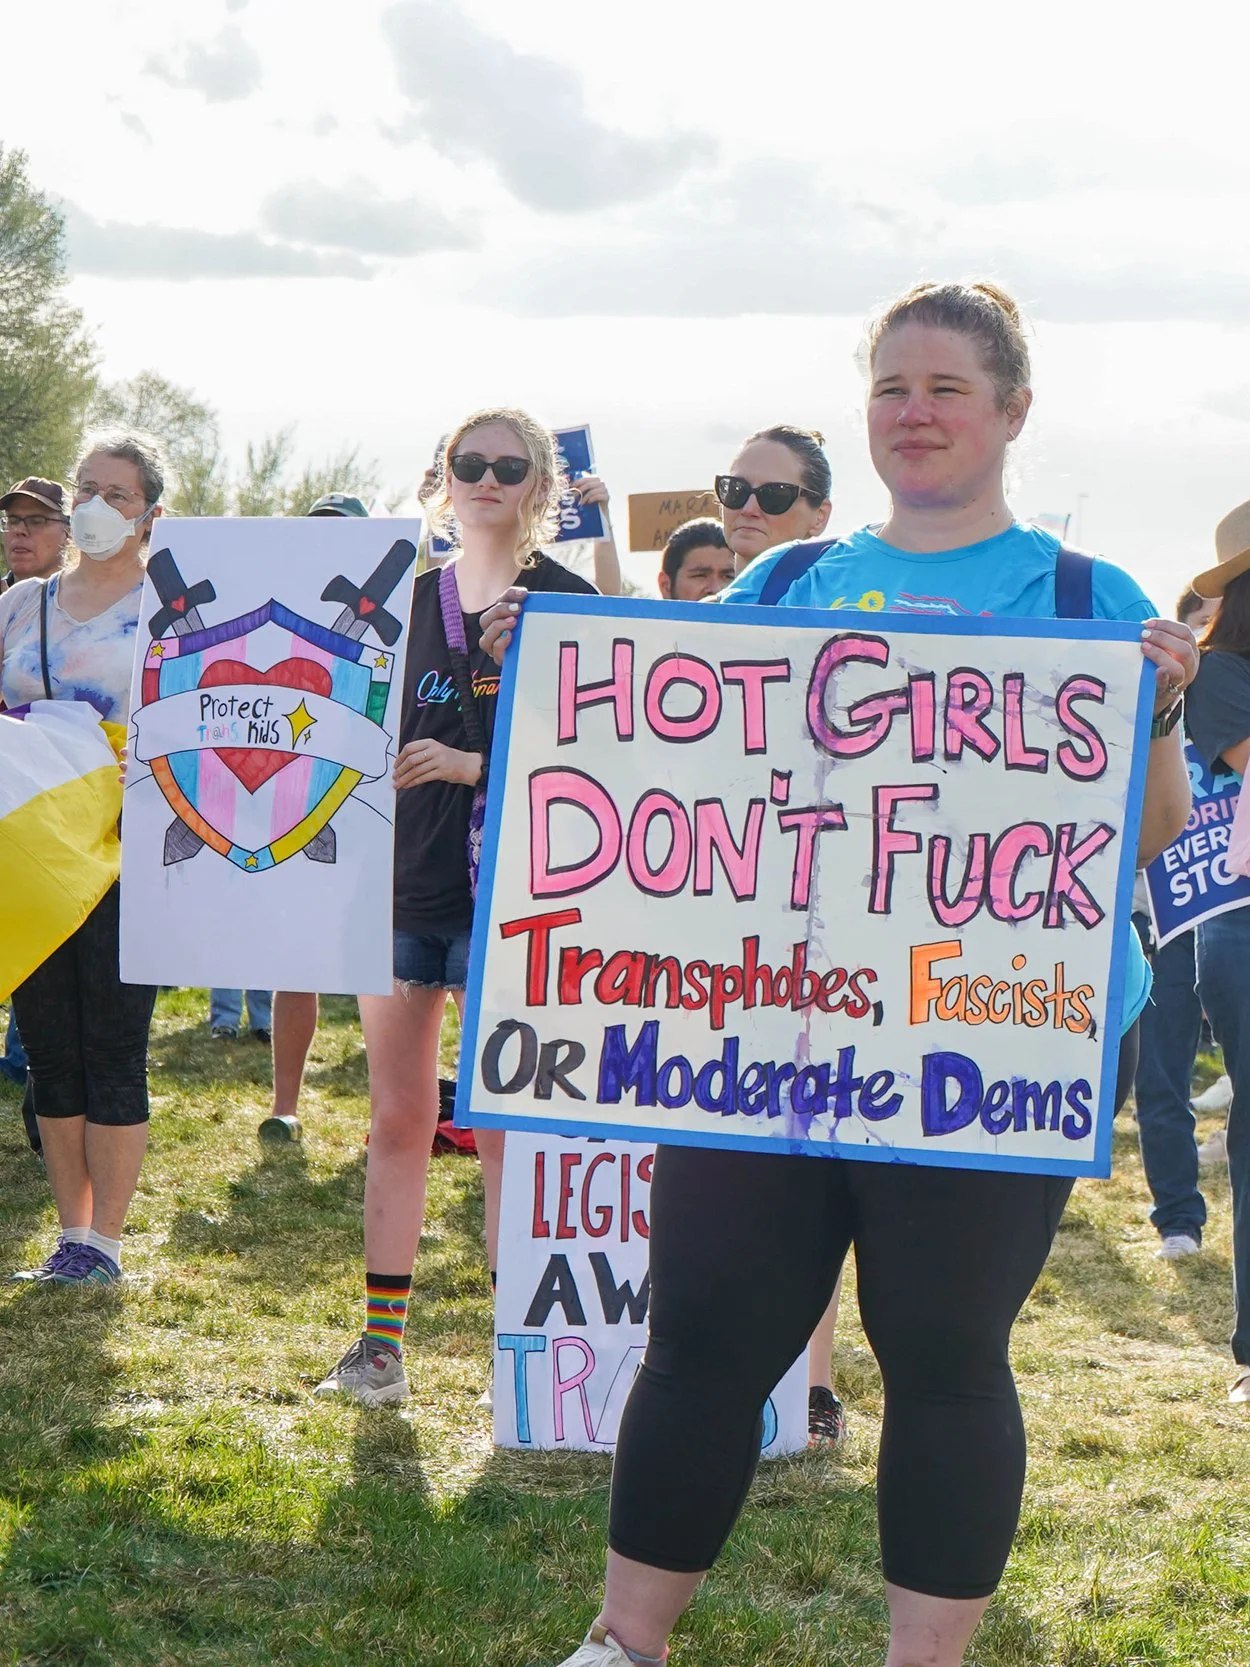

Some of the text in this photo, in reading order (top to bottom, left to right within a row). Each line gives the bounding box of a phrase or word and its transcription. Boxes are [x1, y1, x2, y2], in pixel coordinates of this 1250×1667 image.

[200, 693, 274, 721] Protect
[558, 633, 1107, 782] HOT GIRLS
[528, 765, 1116, 929] DON'T FUCK
[499, 908, 1098, 1041] Transphobes, Fascists,
[481, 1018, 1093, 1140] OR Moderate Dems
